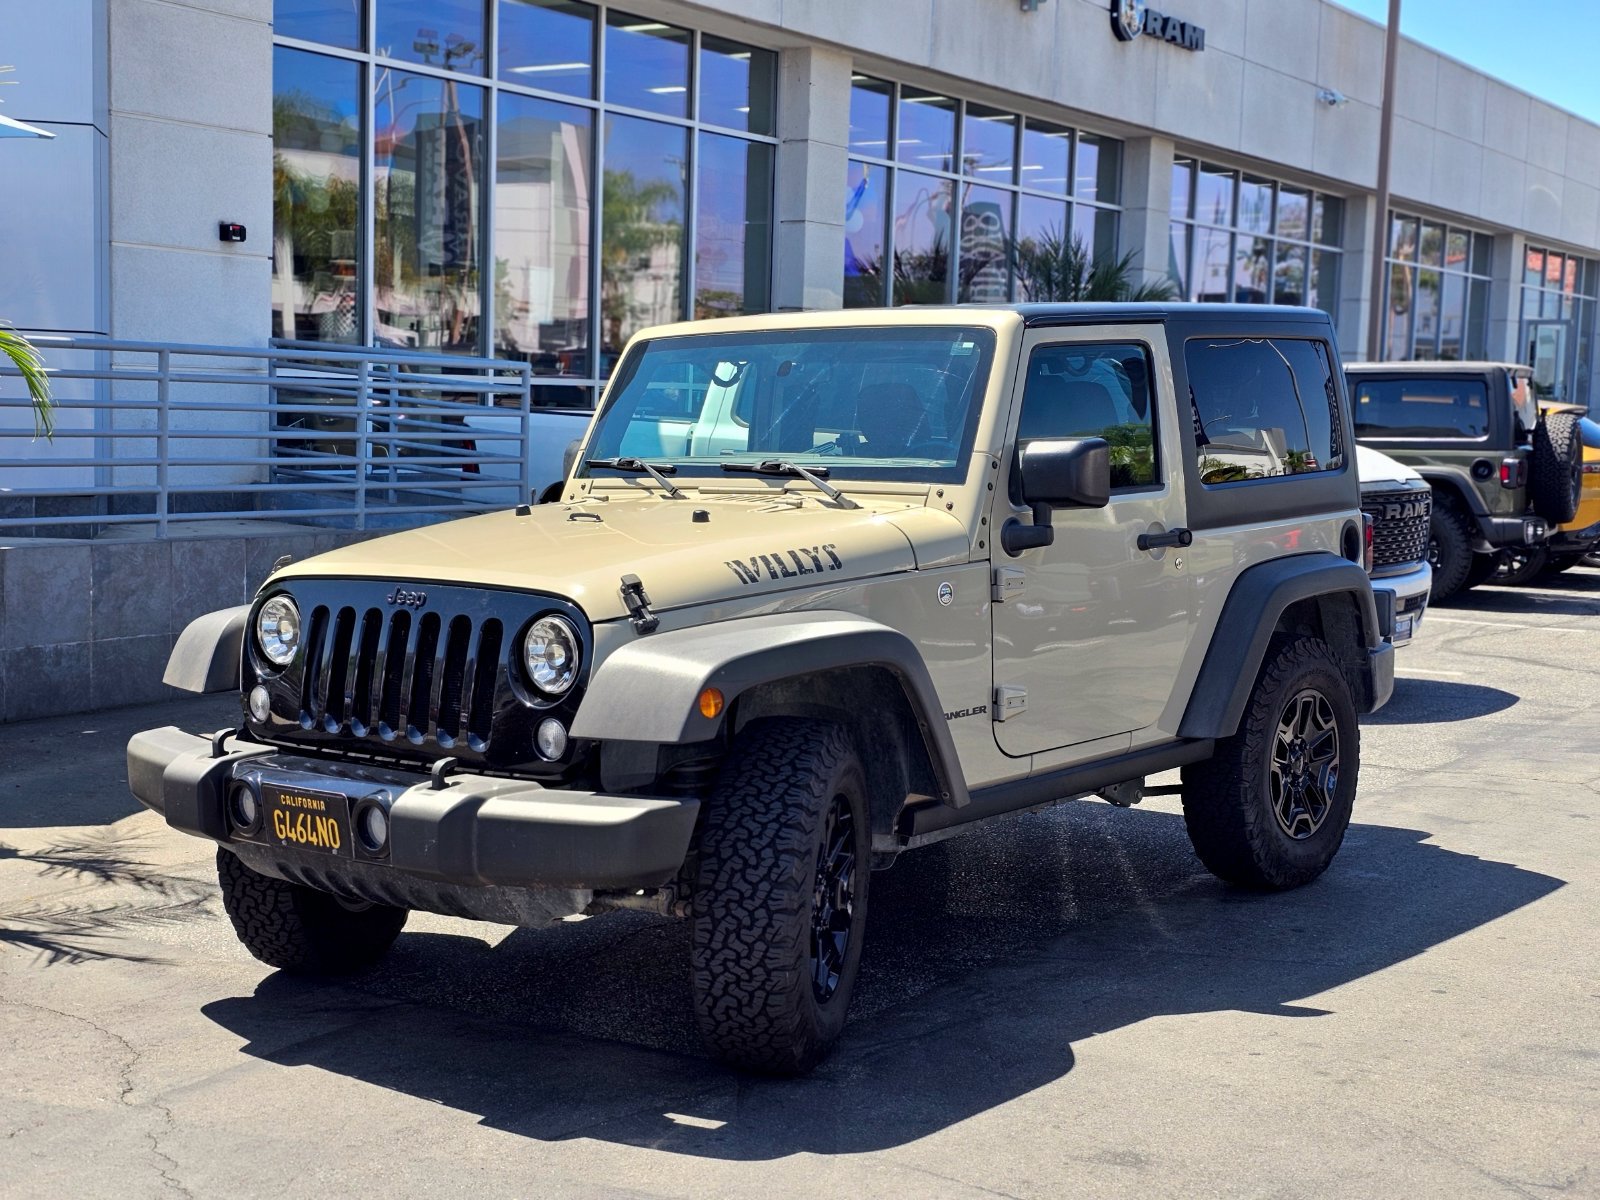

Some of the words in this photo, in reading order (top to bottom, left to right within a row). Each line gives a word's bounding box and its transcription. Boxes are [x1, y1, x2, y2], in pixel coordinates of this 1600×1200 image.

[1142, 8, 1205, 51] RAM
[1385, 502, 1424, 519] RAM
[723, 543, 843, 585] WILLYS
[386, 585, 427, 611] Jeep
[943, 705, 987, 720] ANGLER
[280, 794, 326, 811] CALIFORNIA
